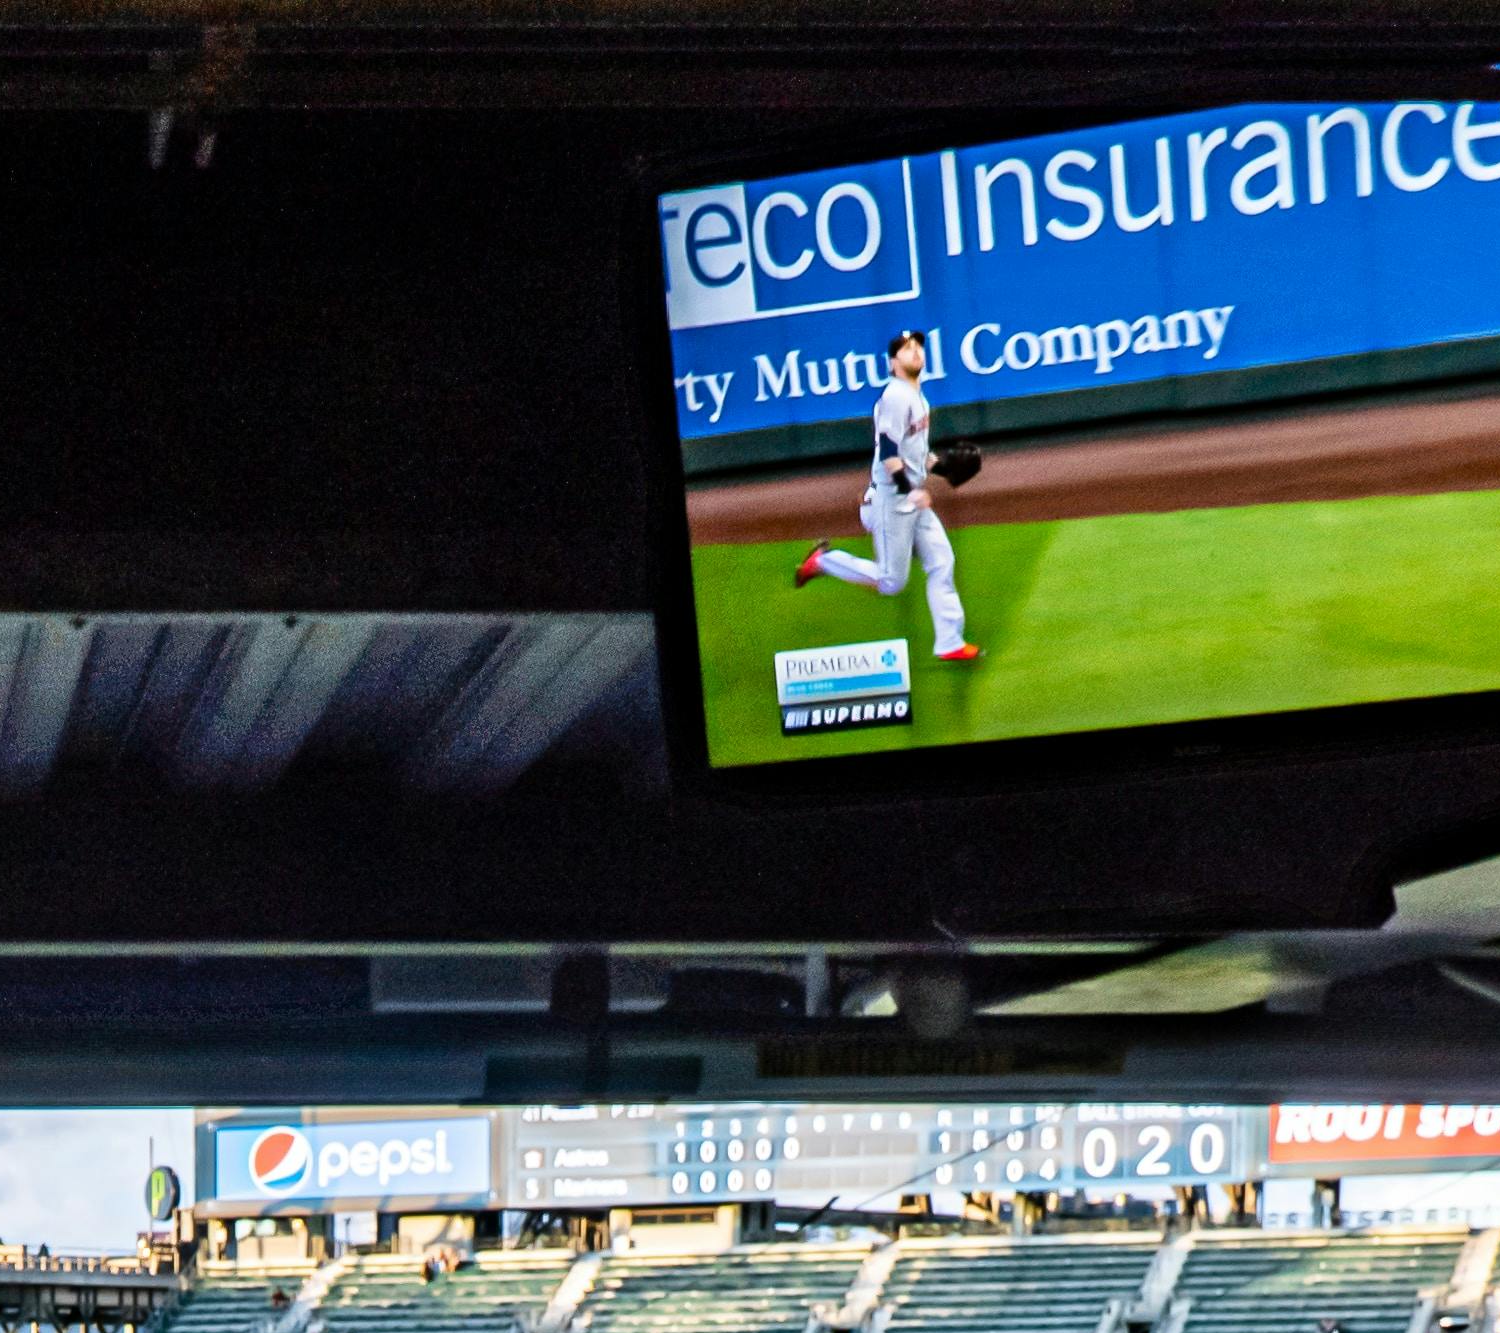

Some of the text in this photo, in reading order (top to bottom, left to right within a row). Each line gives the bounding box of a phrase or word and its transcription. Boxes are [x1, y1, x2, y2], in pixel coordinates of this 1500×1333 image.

[661, 182, 882, 287] eco
[676, 306, 1235, 422] ty Mutul Company
[785, 653, 870, 679] PREMERA
[318, 1130, 452, 1187] pepsi
[1083, 1123, 1225, 1178] 0 2 0
